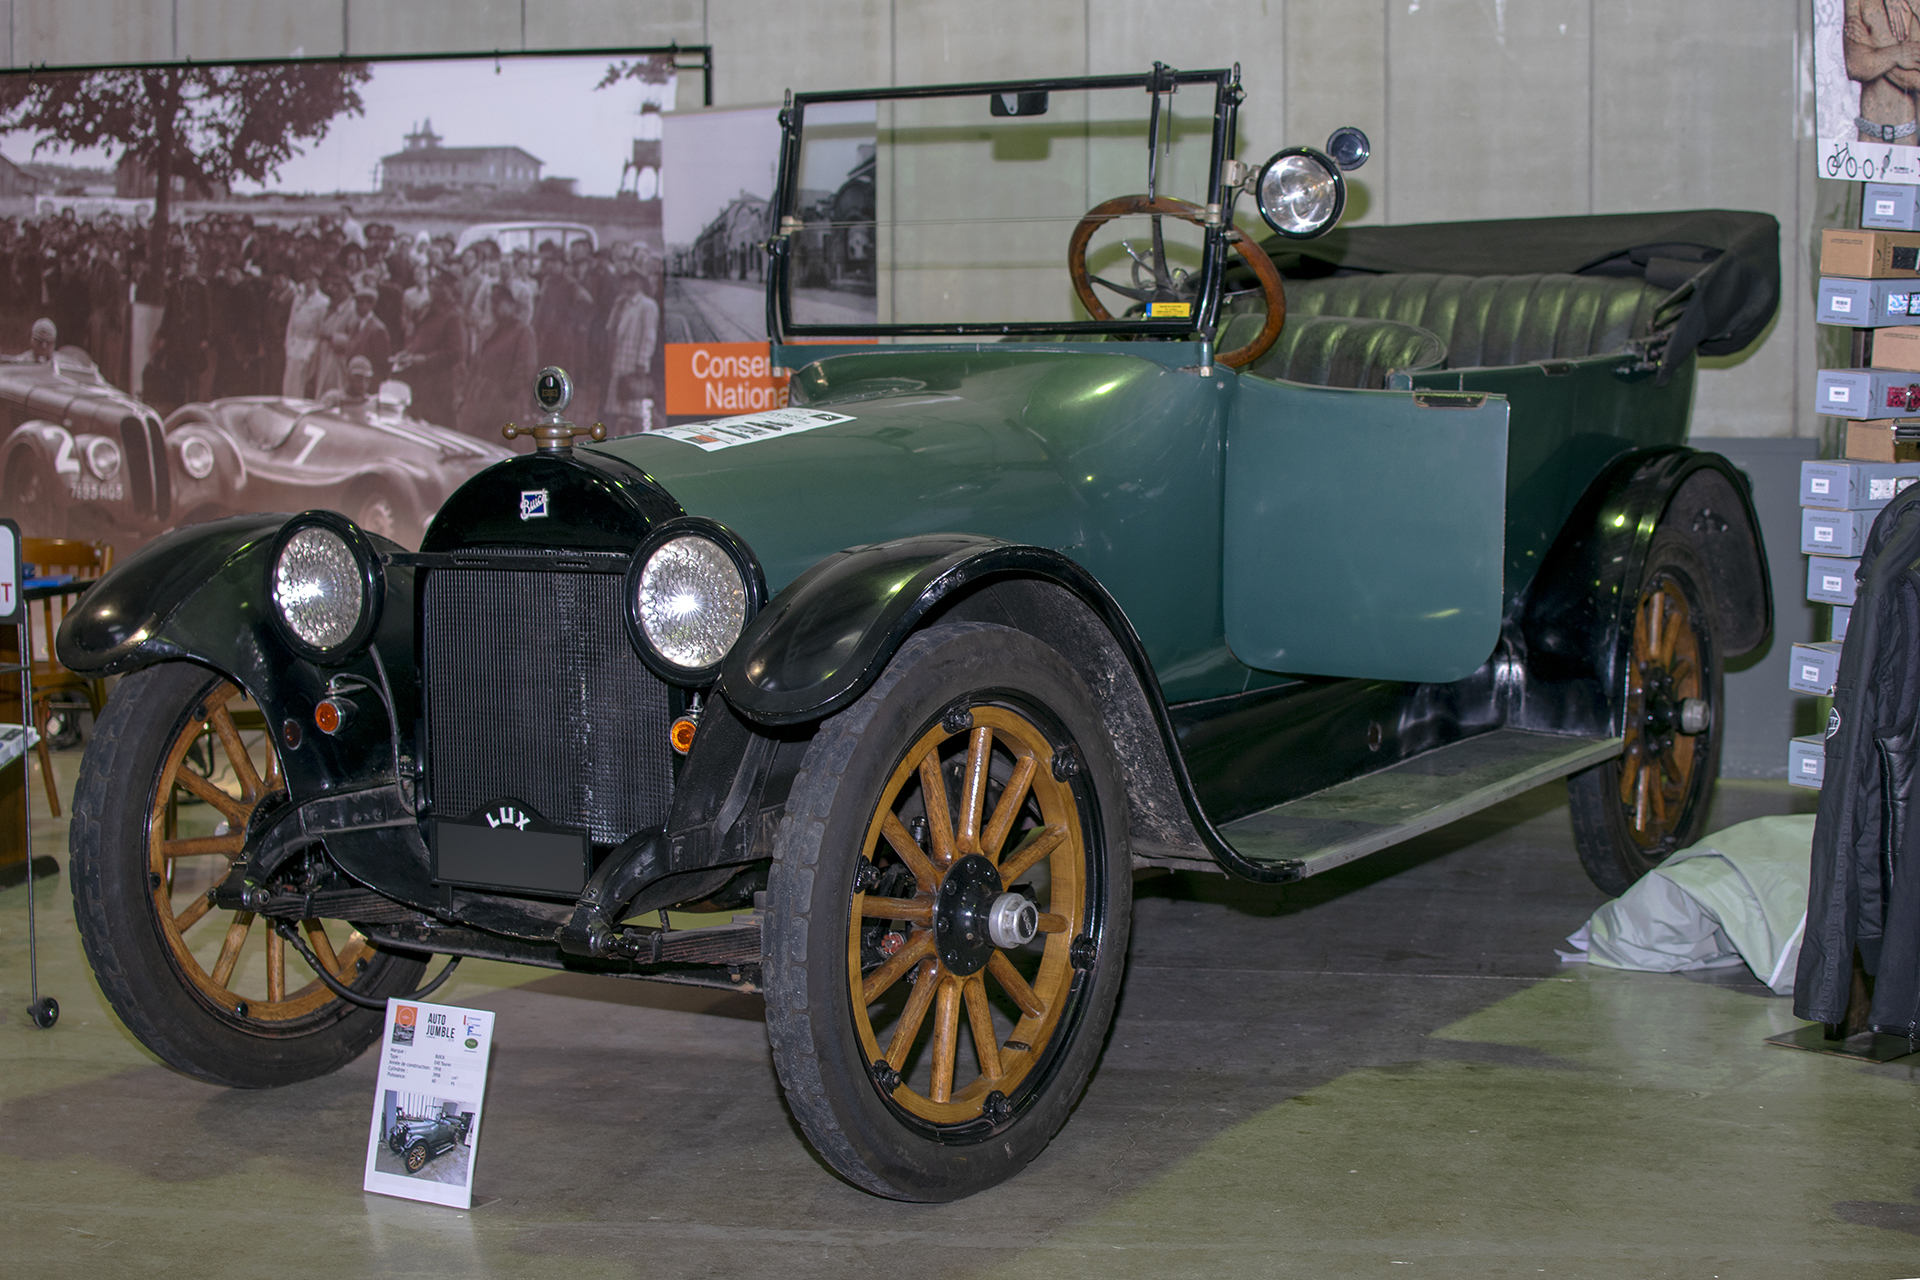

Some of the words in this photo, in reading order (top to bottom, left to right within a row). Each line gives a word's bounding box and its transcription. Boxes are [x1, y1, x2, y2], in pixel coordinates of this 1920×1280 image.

[691, 349, 771, 379] Conser
[705, 381, 789, 409] Nationa
[42, 425, 81, 474] 2
[293, 424, 326, 466] 7
[519, 487, 550, 519] Buick
[0, 583, 12, 602] T
[485, 806, 531, 831] LUX
[425, 1024, 456, 1039] JUMBLE
[427, 1012, 447, 1026] AUTO
